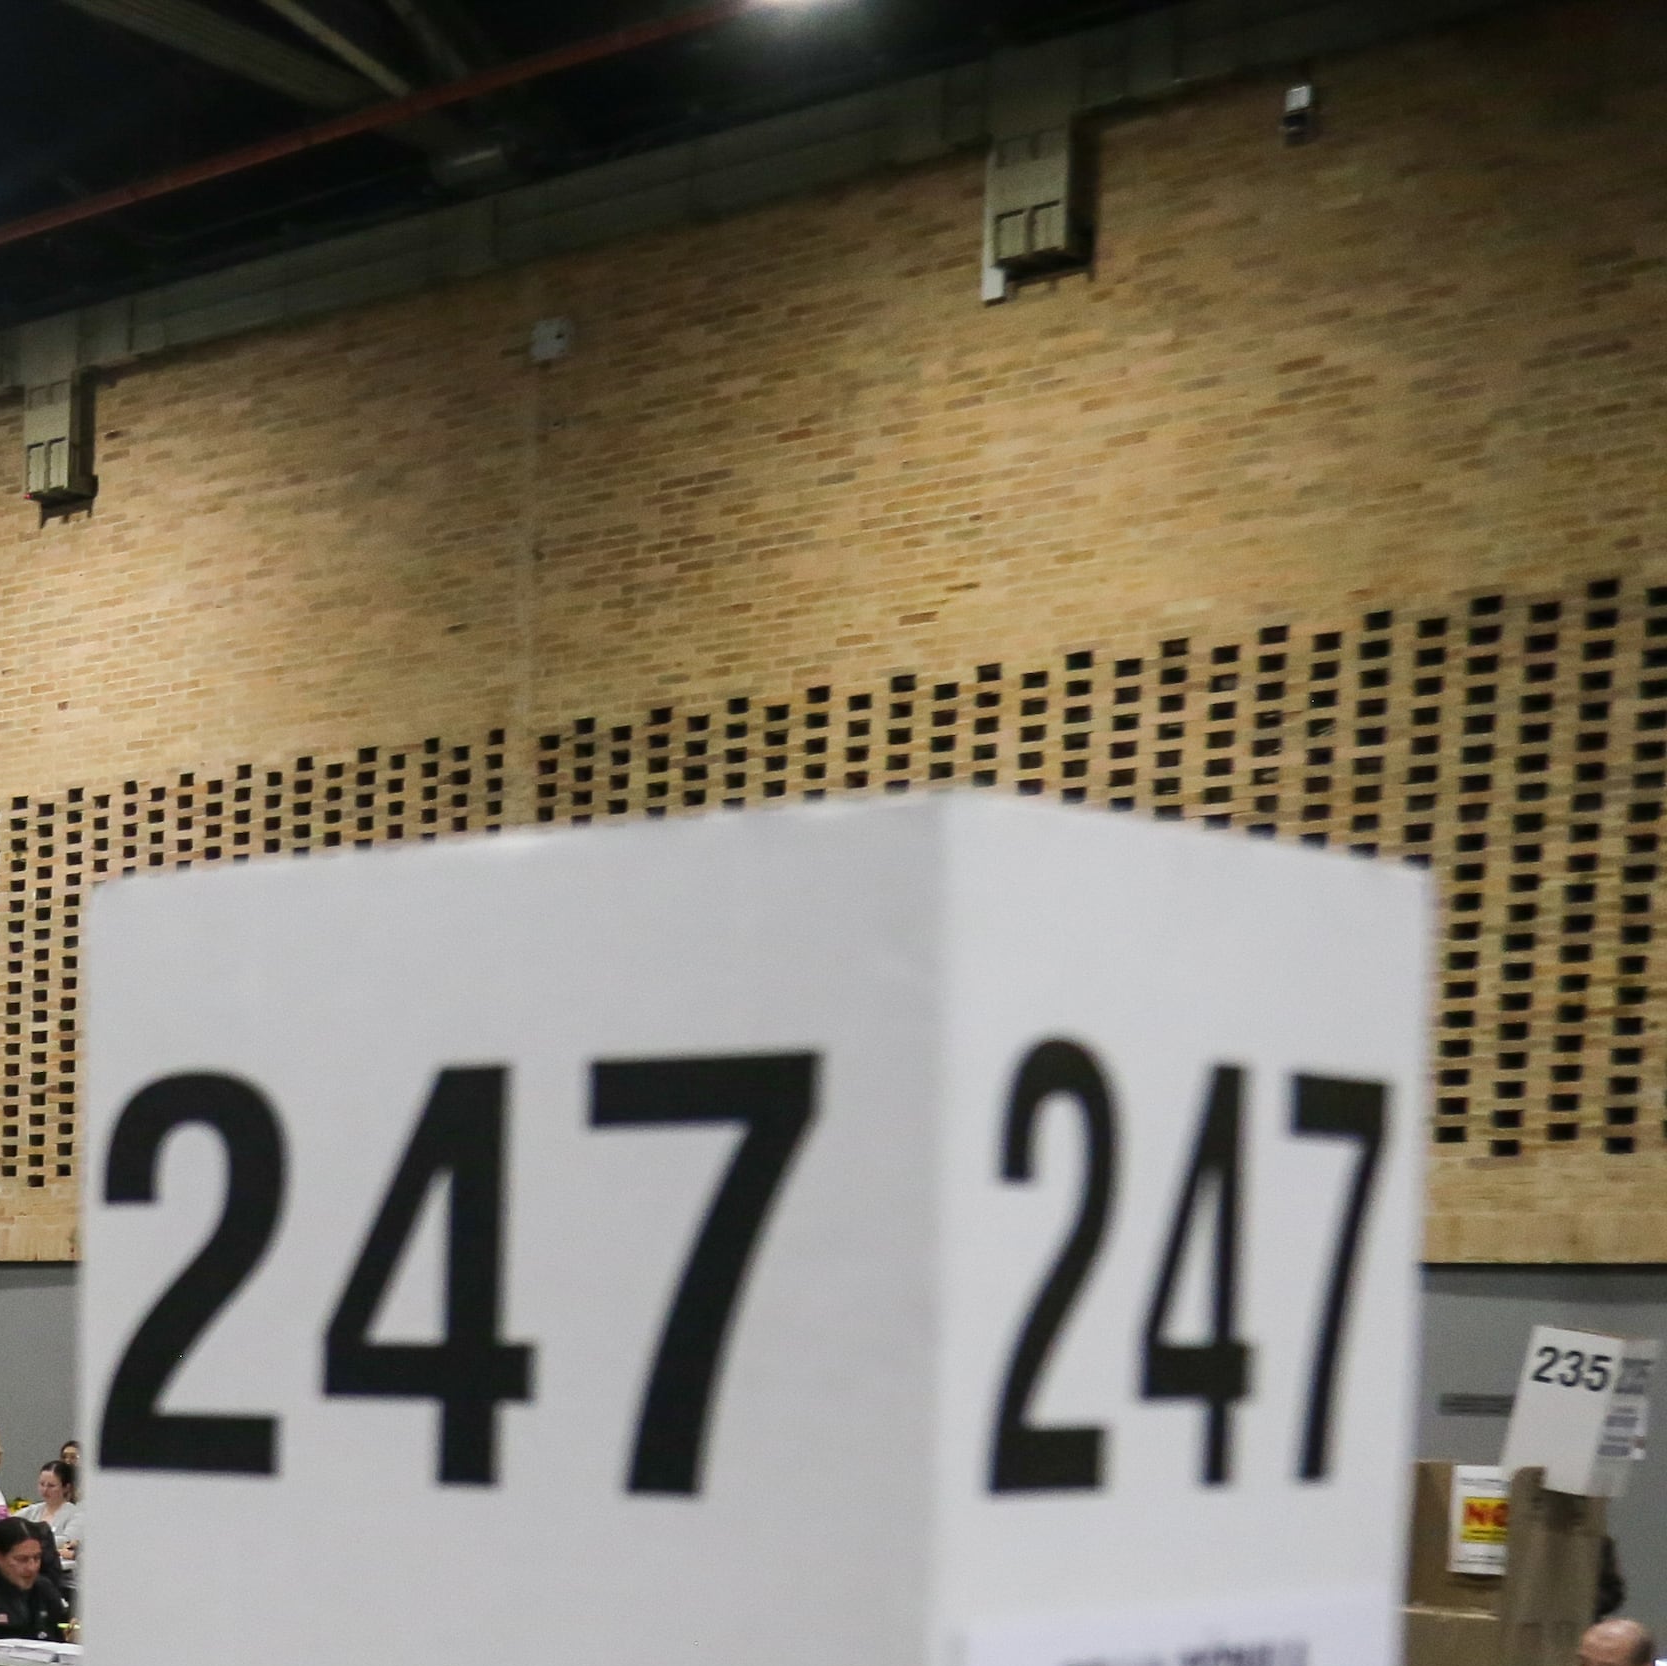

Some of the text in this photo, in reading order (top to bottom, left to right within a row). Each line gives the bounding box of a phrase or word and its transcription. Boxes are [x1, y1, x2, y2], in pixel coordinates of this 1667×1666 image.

[97, 1050, 824, 1498] 247
[987, 1037, 1391, 1495] 247
[1531, 1346, 1612, 1392] 235
